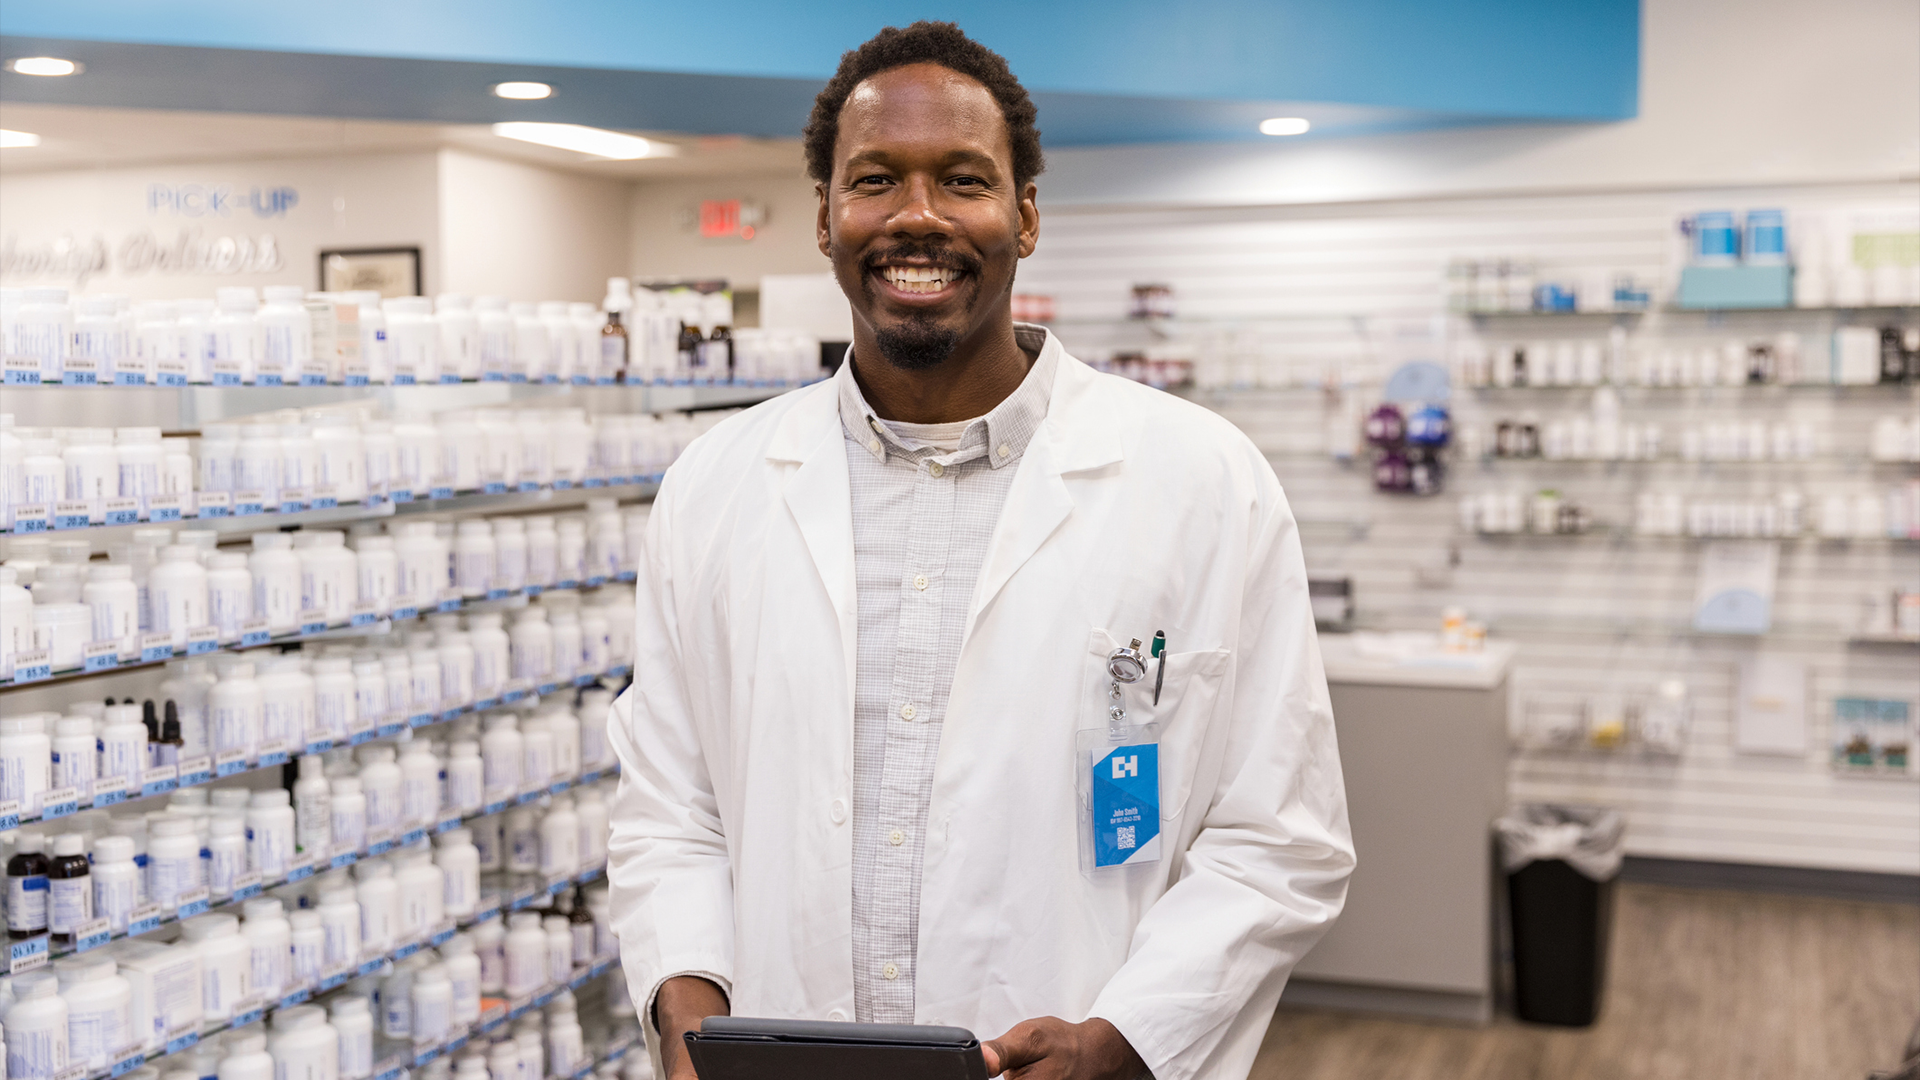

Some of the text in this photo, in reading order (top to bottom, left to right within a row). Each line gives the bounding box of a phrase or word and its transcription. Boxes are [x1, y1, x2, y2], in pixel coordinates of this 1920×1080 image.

[148, 184, 300, 218] PICK-UP
[1113, 807, 1138, 817] John Smith
